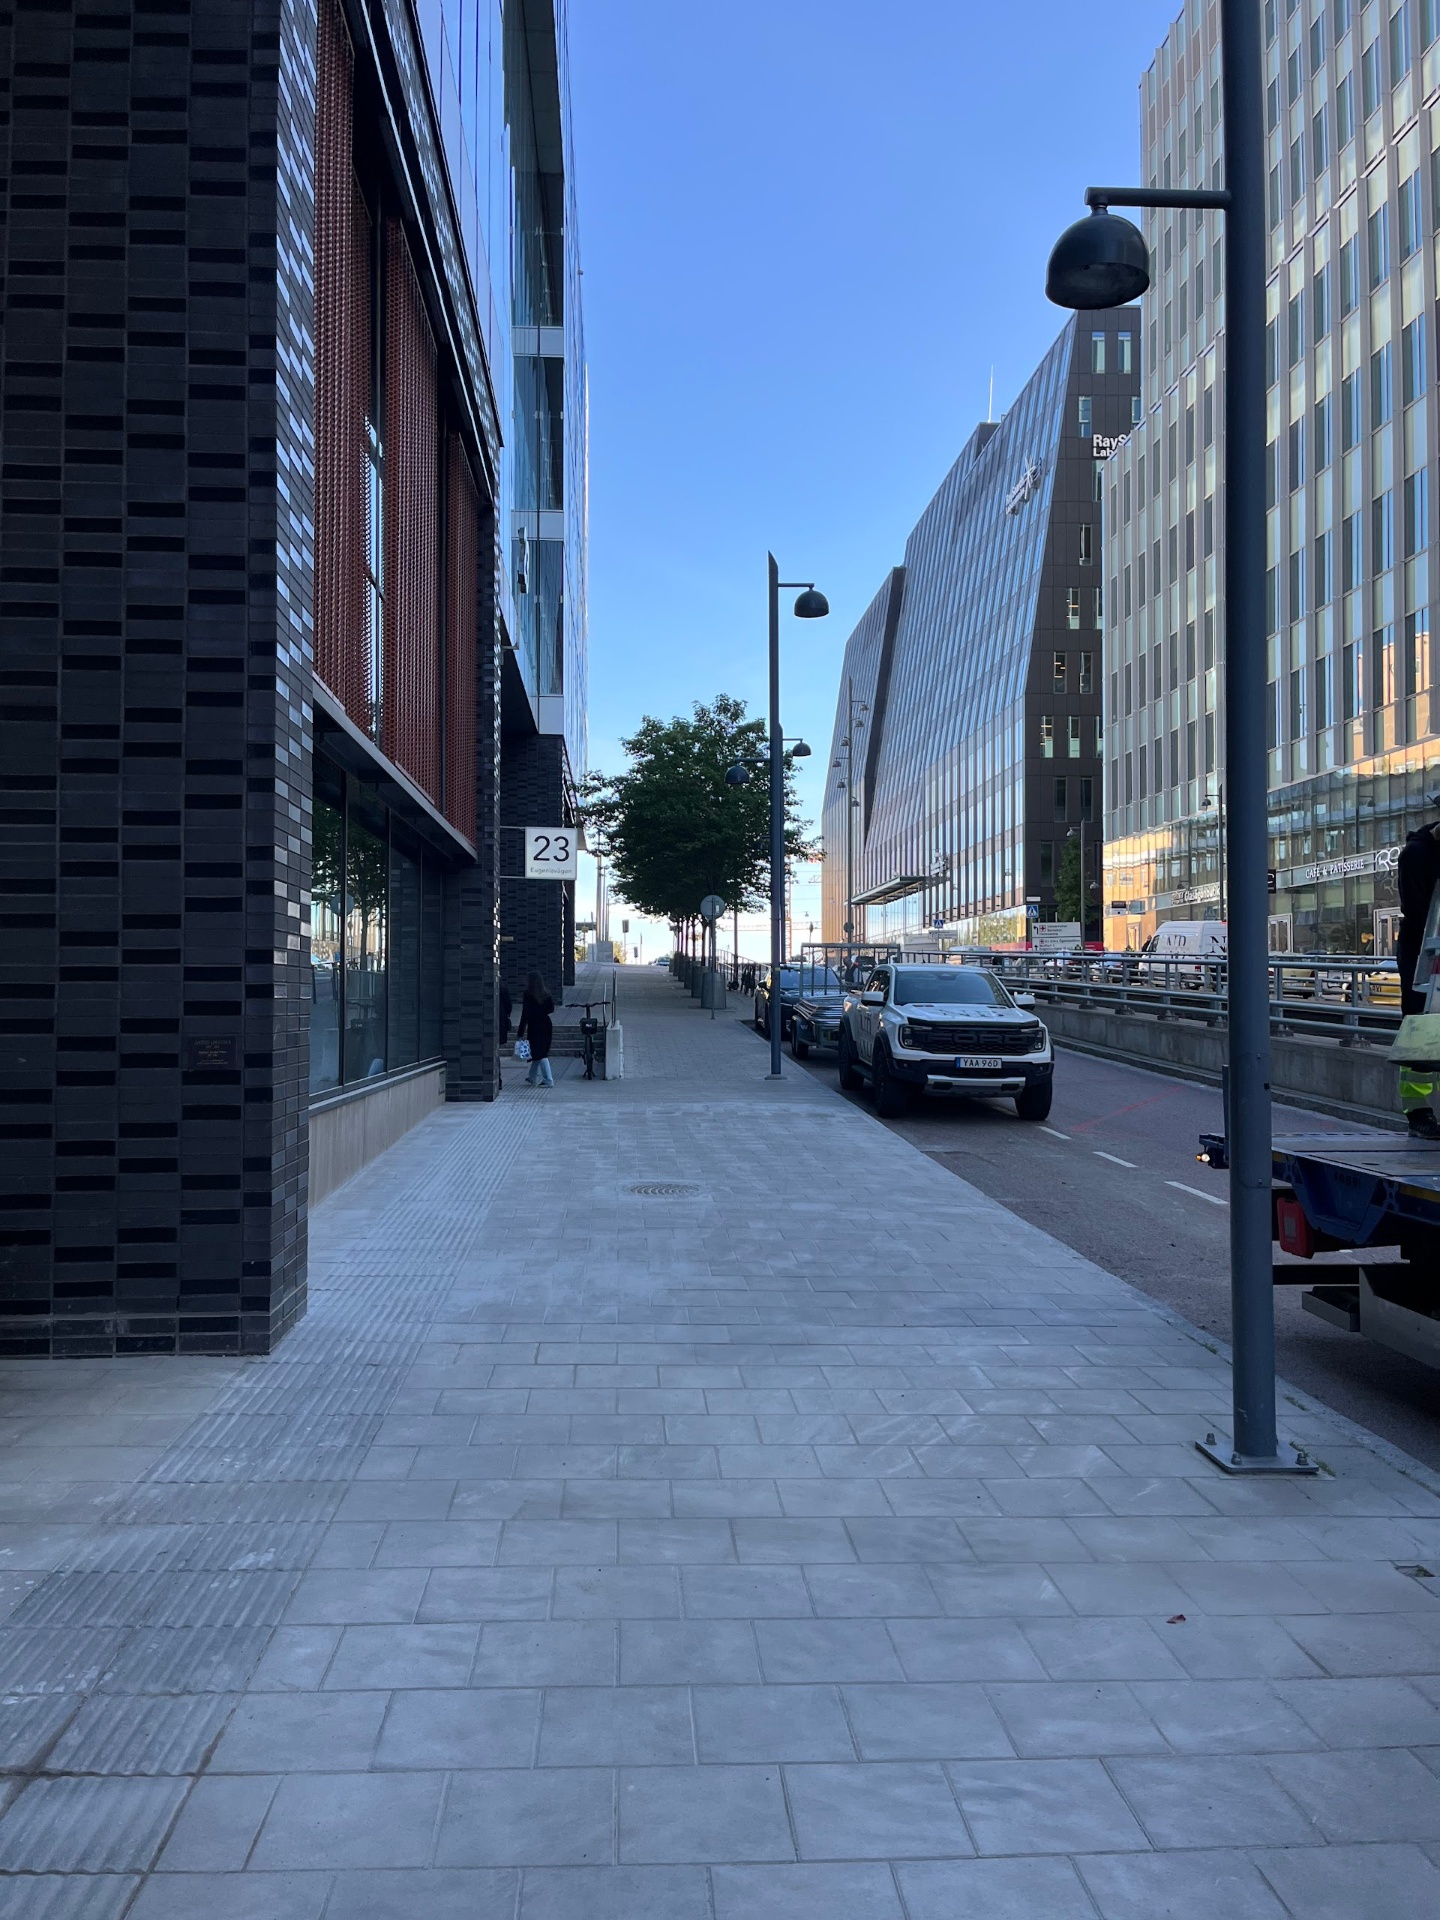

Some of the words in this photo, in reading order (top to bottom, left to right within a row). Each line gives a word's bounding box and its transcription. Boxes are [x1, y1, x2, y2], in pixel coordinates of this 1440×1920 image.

[533, 835, 570, 862] 23
[530, 866, 573, 875] Eugeniavägen
[1305, 864, 1320, 879] CAFÉ
[1322, 866, 1328, 876] &
[1330, 858, 1365, 875] PÂTISSERIE
[963, 1059, 980, 1067] YAA
[981, 1059, 998, 1067] 96D
